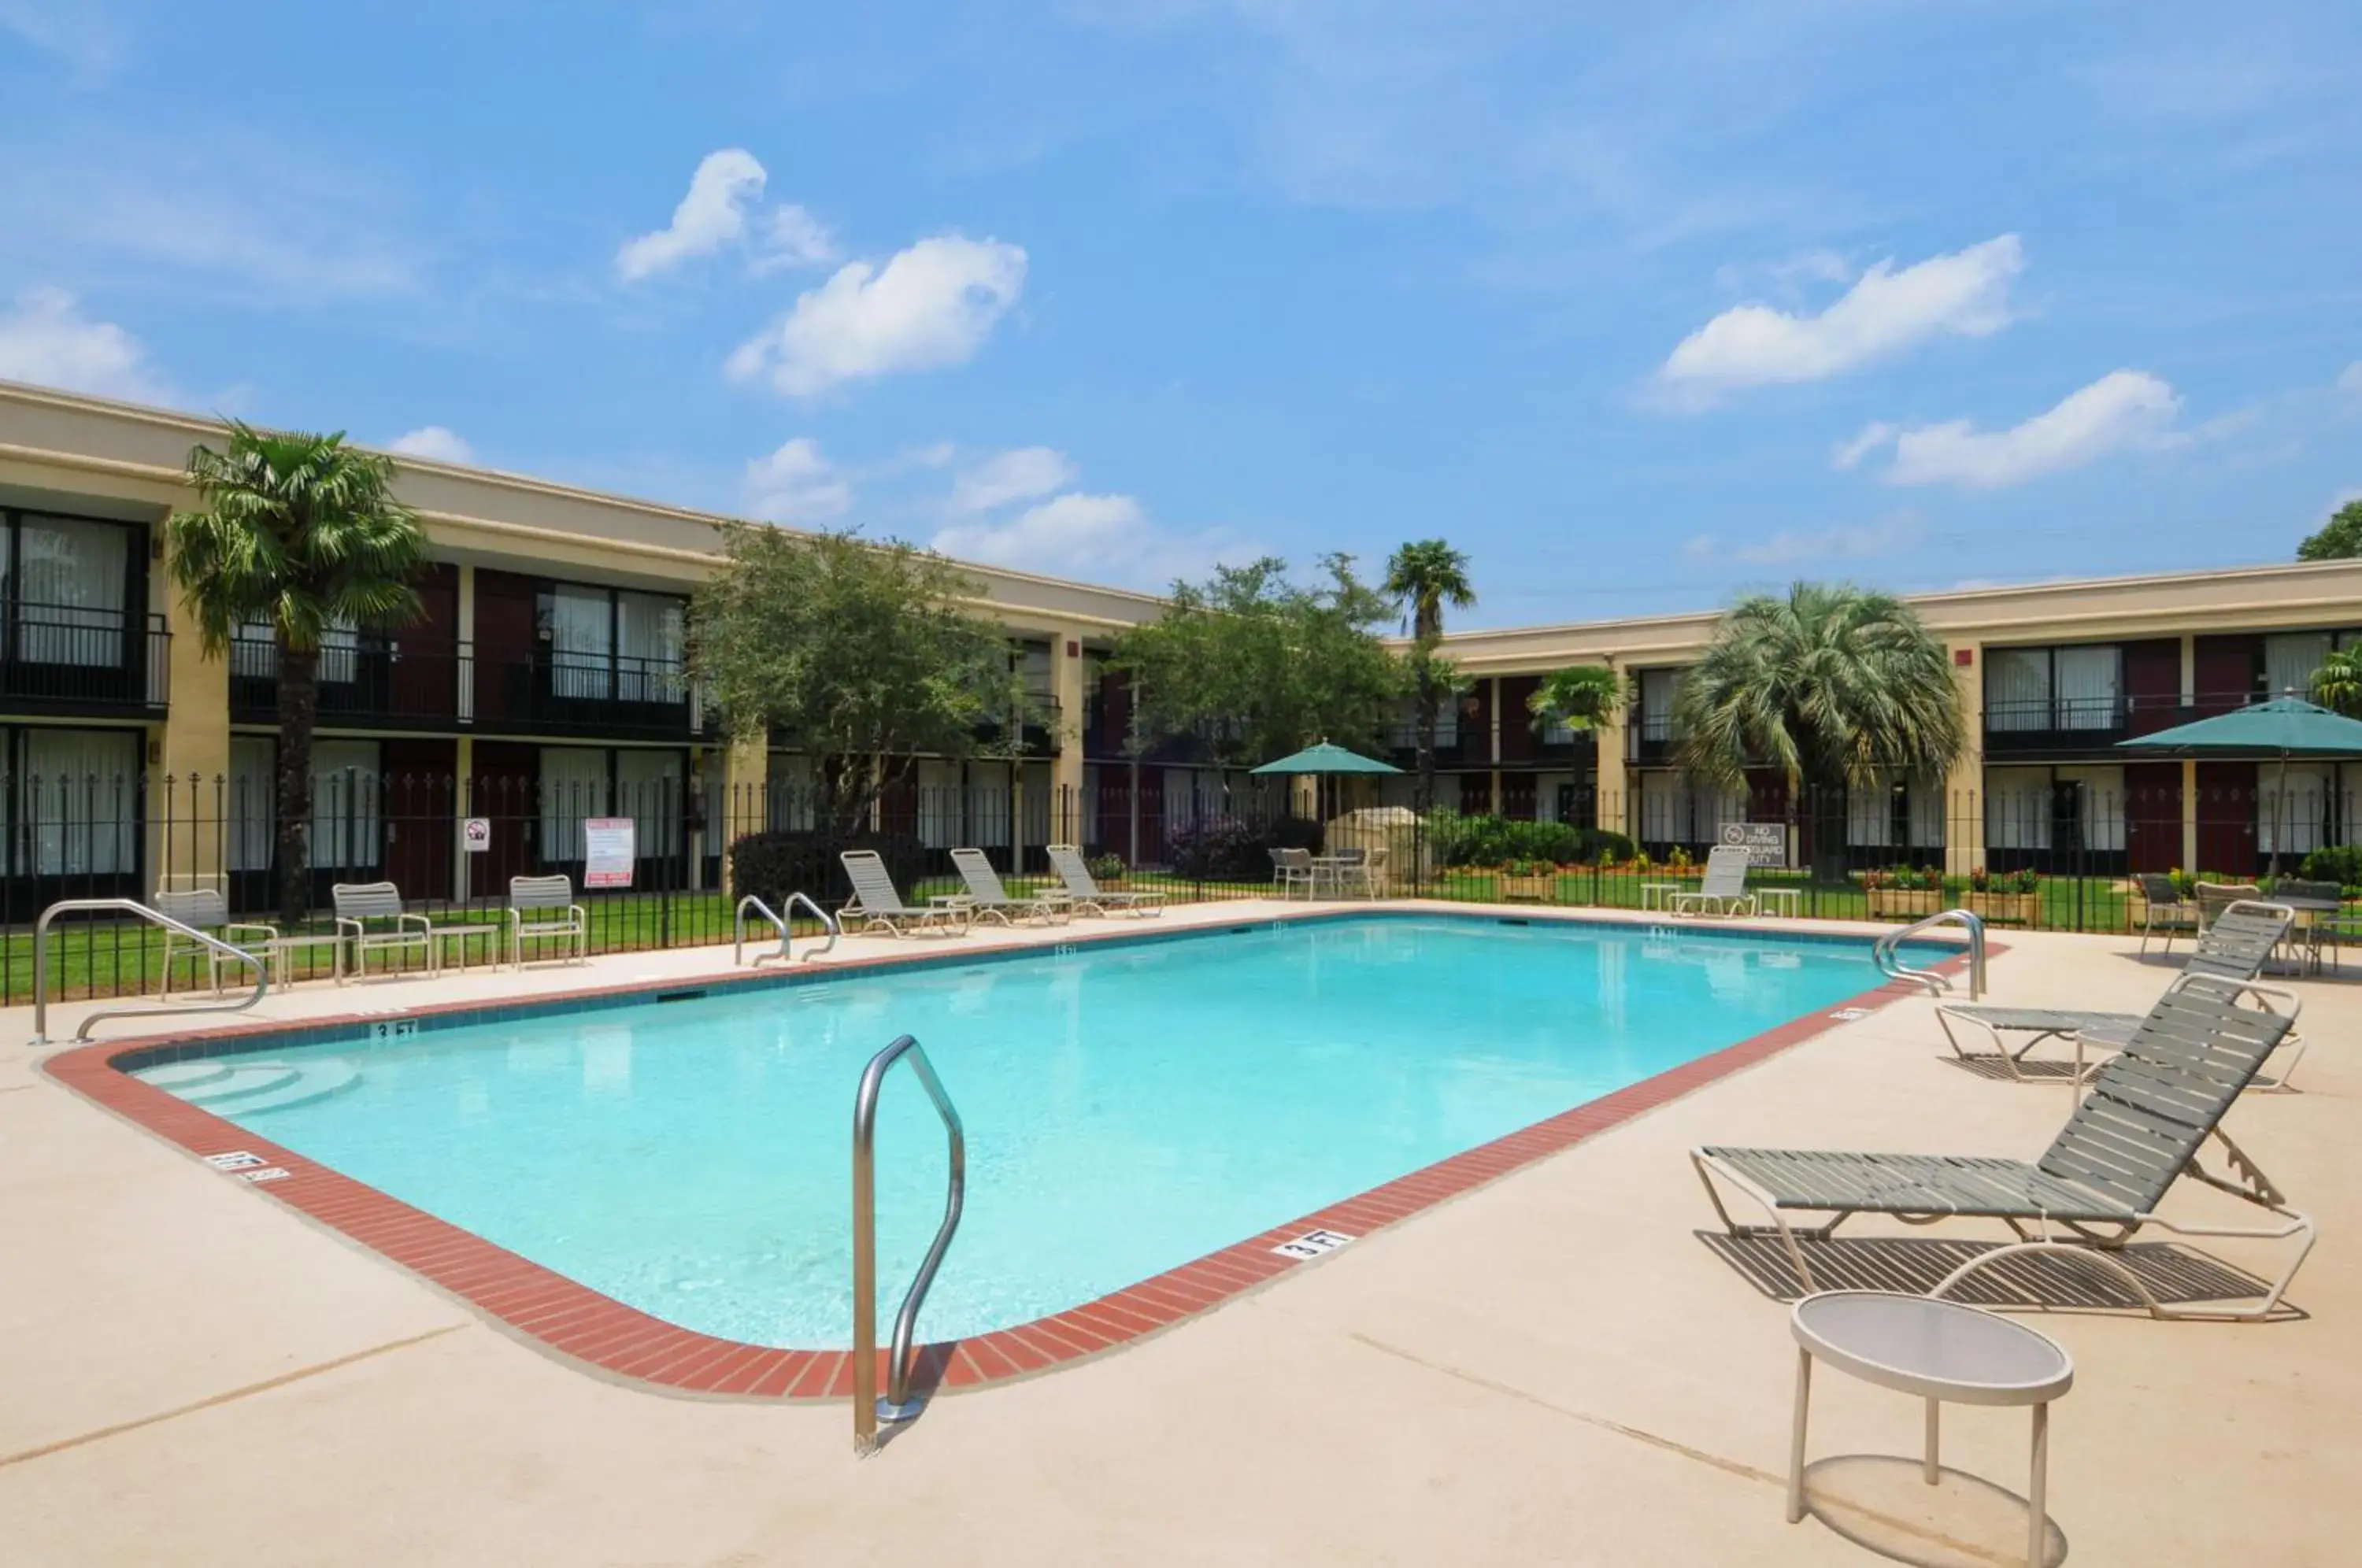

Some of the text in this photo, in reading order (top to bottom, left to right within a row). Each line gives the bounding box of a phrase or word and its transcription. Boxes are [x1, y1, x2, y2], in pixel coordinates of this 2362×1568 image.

[1755, 827, 1770, 835] NO
[1746, 835, 1779, 845] DIVING
[1284, 1230, 1349, 1255] 3 FT
